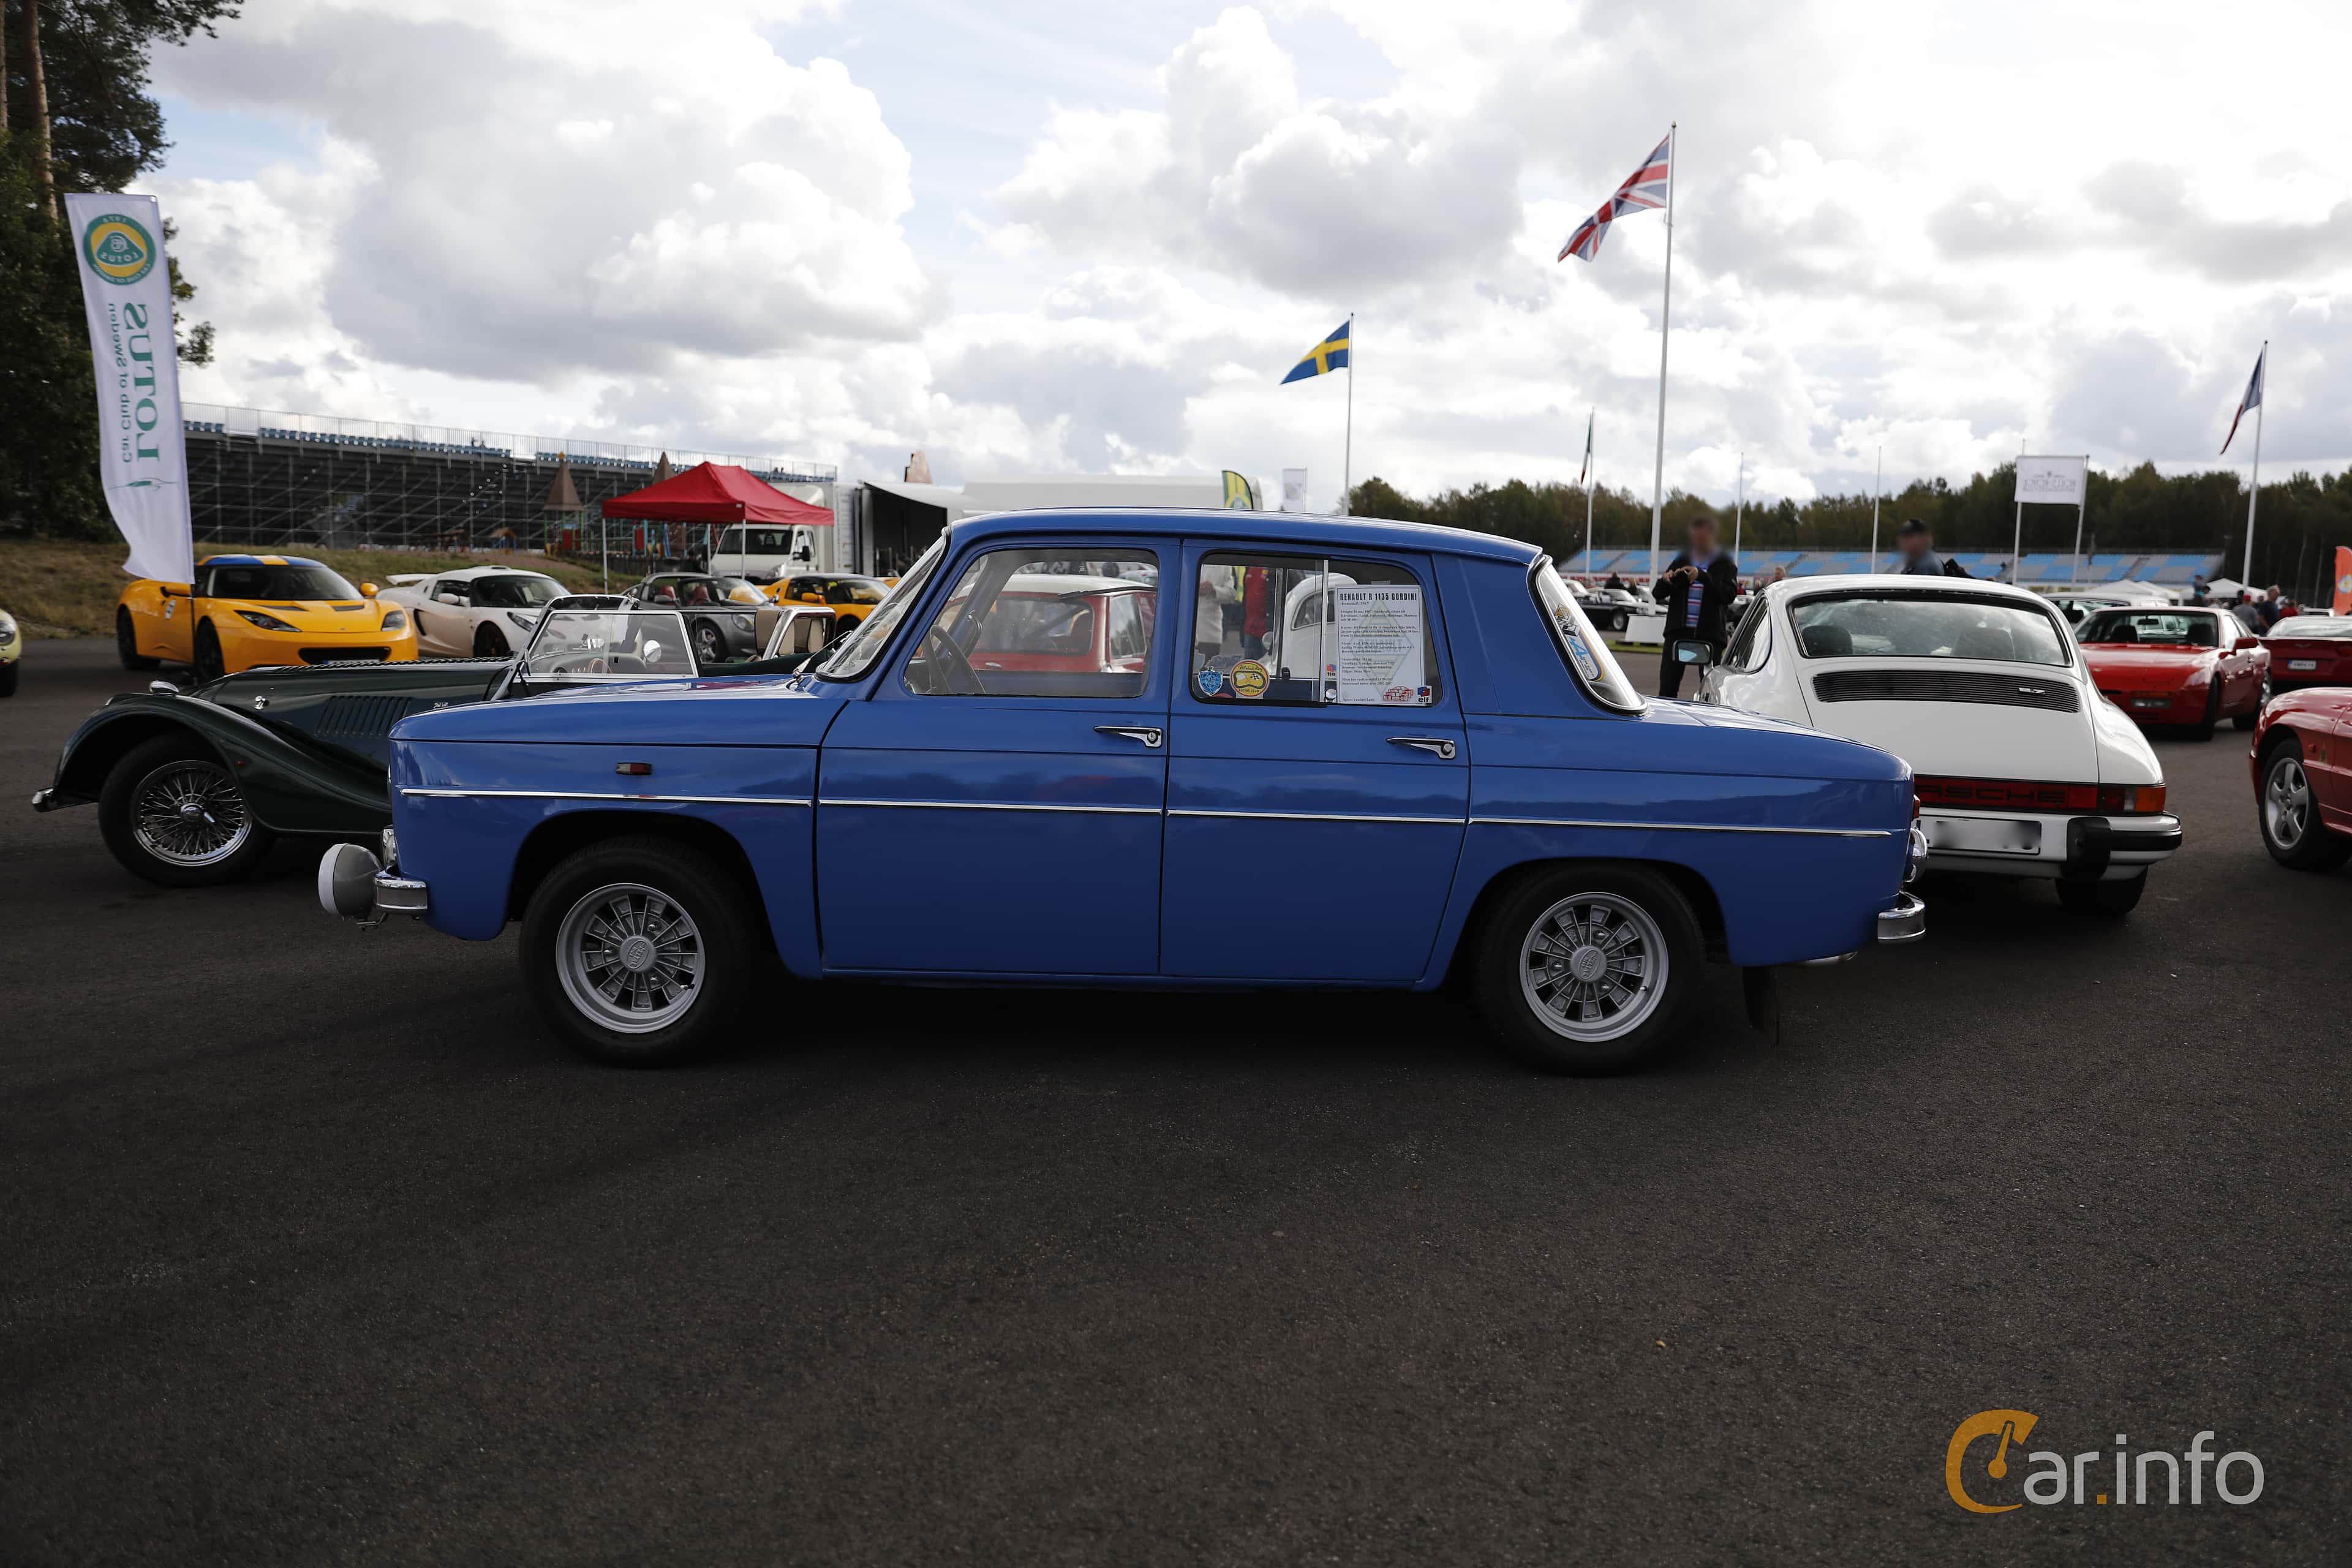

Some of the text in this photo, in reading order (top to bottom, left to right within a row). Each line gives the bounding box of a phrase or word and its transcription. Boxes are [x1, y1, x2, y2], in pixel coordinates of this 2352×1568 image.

[1374, 592, 1389, 601] 1135
[1391, 592, 1417, 601] GORDINI
[1915, 785, 2066, 804] RSCHE
